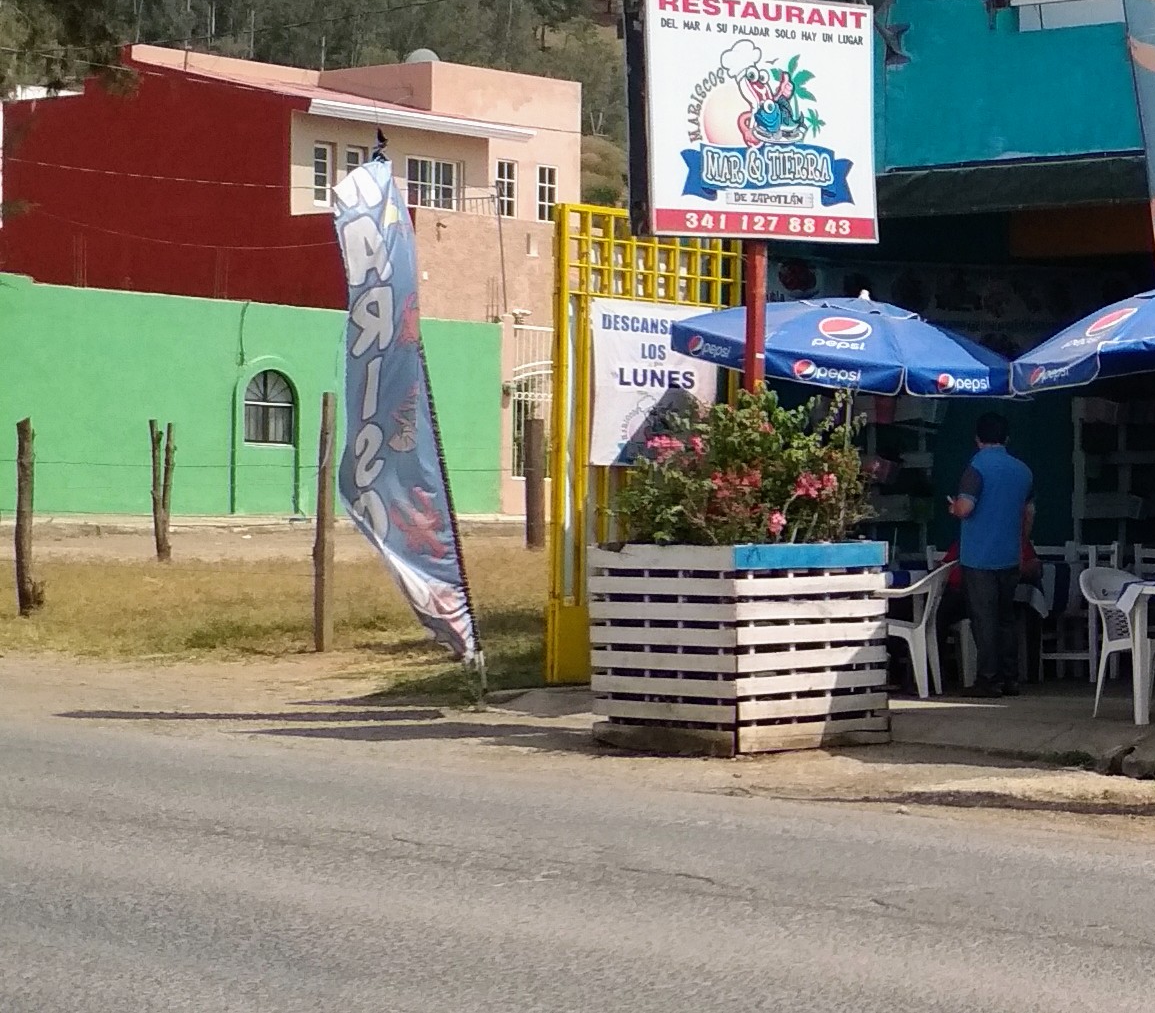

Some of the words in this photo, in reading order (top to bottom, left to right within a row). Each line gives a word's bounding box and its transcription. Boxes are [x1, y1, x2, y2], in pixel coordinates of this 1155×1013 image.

[660, 18, 678, 30] DEL
[683, 20, 701, 32] MAR
[705, 22, 712, 32] A
[716, 23, 728, 34] SU
[732, 24, 770, 38] PALADAR
[775, 29, 797, 40] SOLO
[801, 31, 818, 42] HAY
[822, 32, 833, 43] UN
[837, 34, 864, 46] LUGAR
[687, 67, 726, 143] MARISCOS
[705, 150, 745, 183] MAR
[746, 148, 765, 183] &
[766, 149, 832, 183] TIERRA
[733, 191, 748, 202] DE
[685, 213, 727, 229] 341
[741, 214, 779, 231] 127
[788, 217, 815, 233] 88
[824, 219, 851, 235] 43
[641, 343, 666, 360] LOS
[702, 342, 732, 358] pepsi
[812, 338, 866, 351] pepsi
[618, 367, 695, 390] LUNES
[816, 366, 862, 382] pepsi
[956, 376, 990, 393] pepsi
